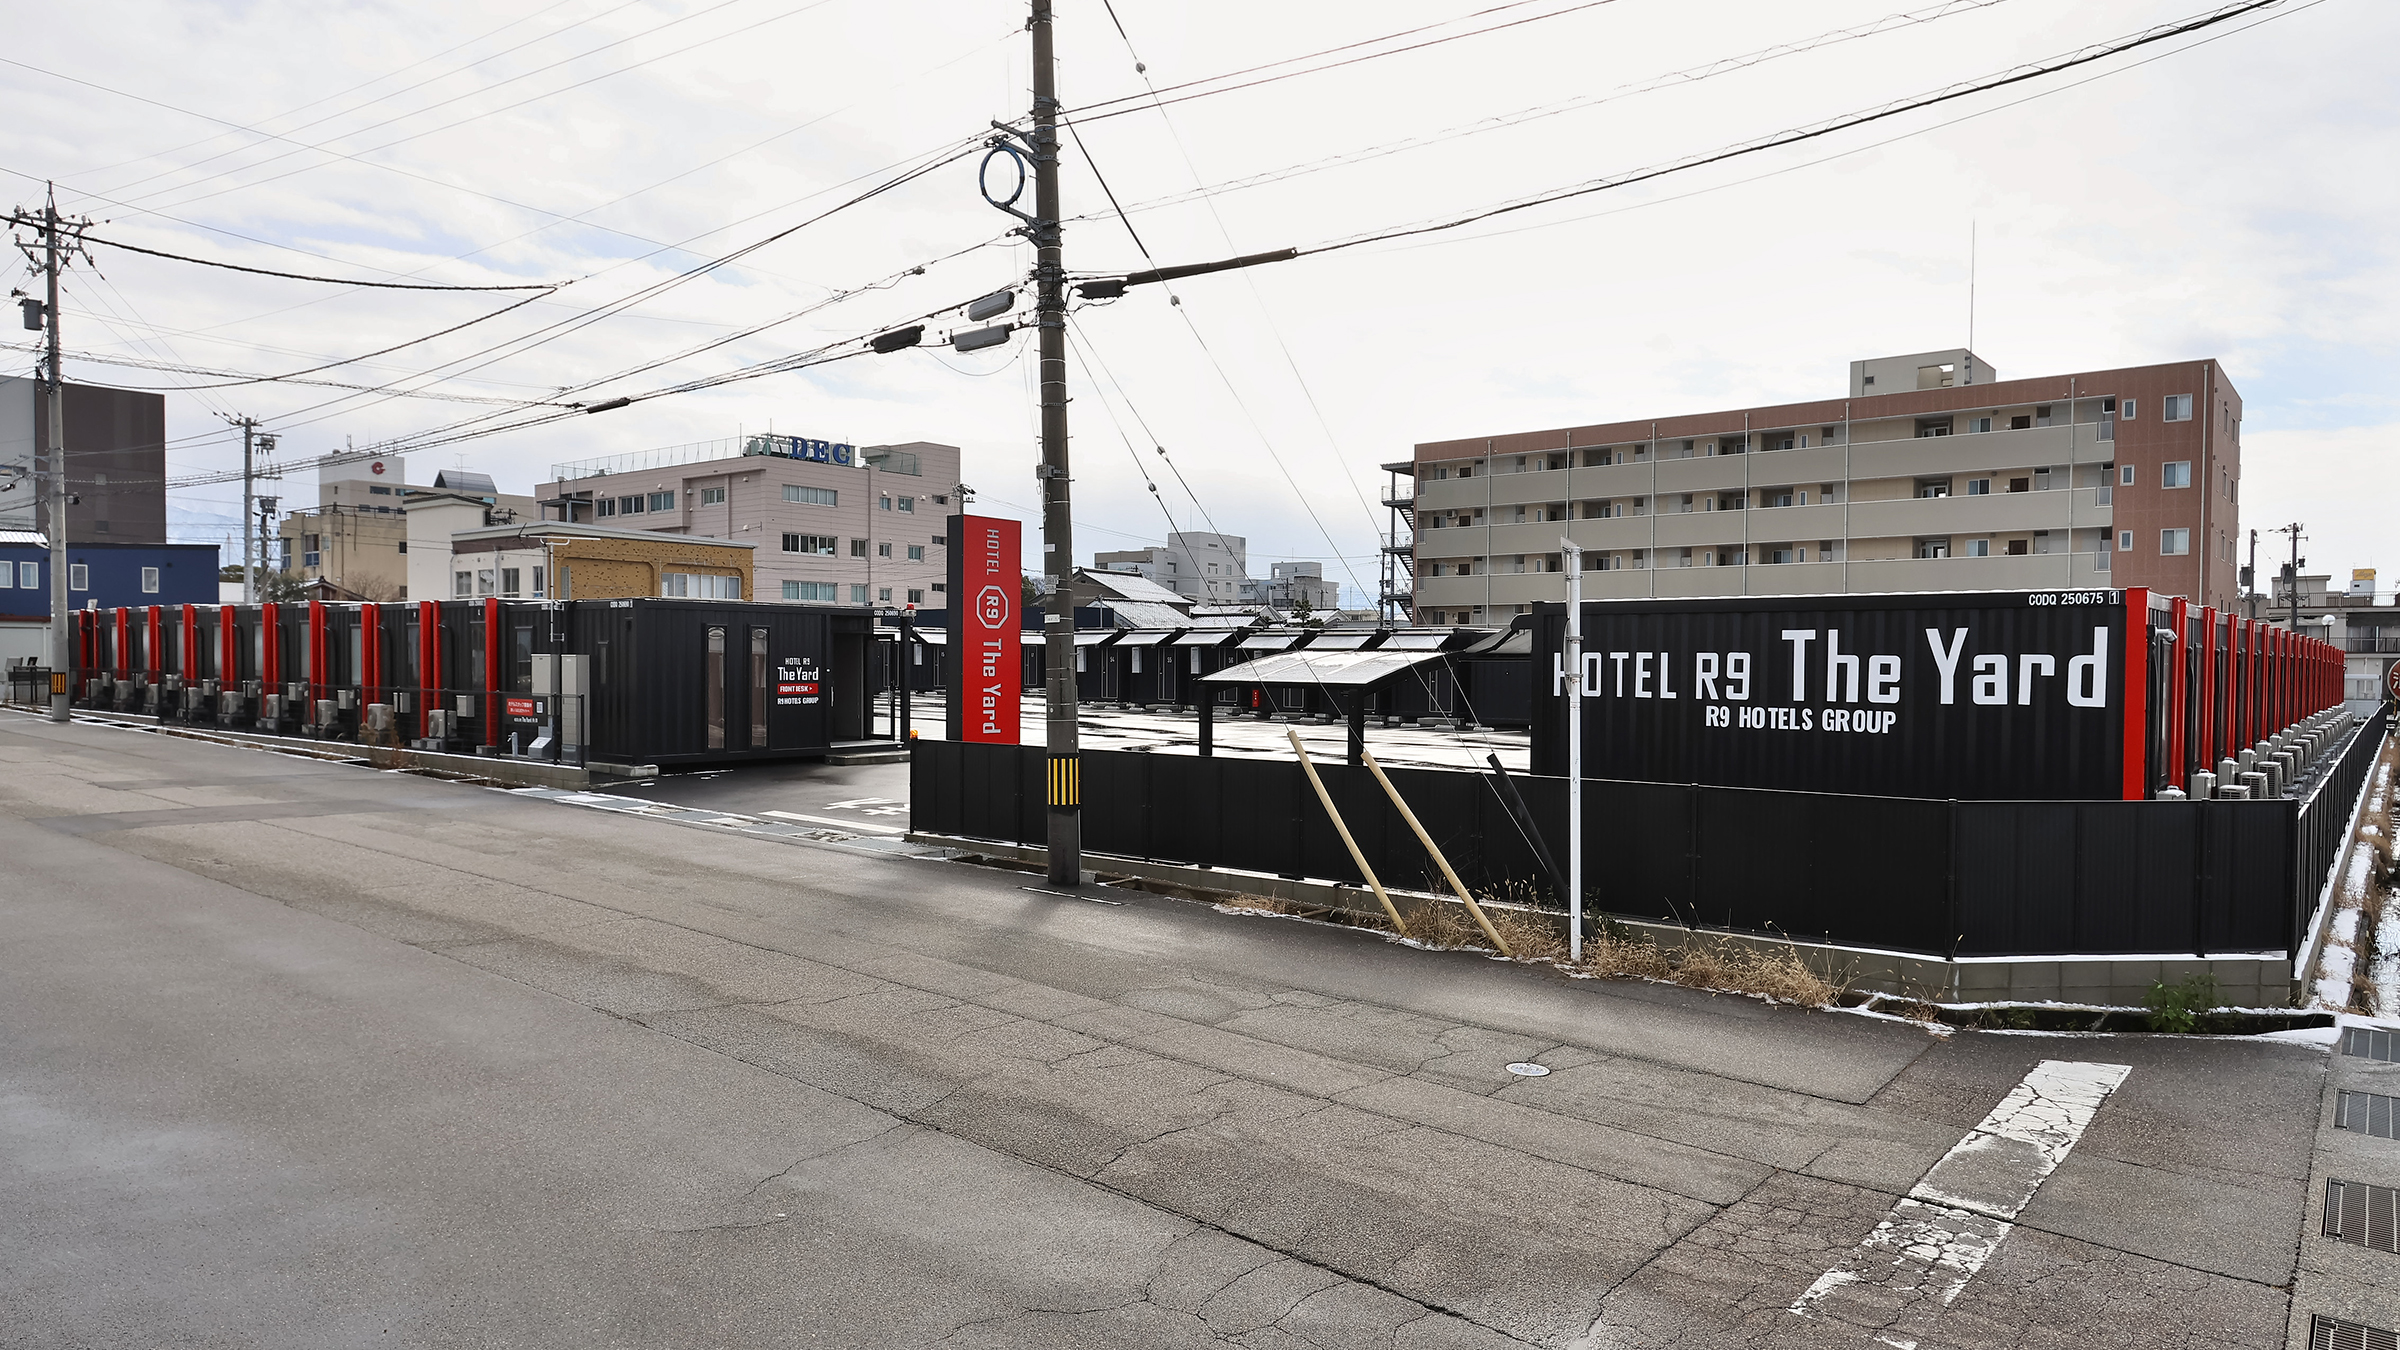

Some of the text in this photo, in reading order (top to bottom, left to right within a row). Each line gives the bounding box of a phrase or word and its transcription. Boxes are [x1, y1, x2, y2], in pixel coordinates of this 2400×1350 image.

[788, 436, 850, 464] DEC
[2028, 594, 2057, 606] CODQ
[2061, 592, 2104, 605] 250675
[982, 528, 1002, 734] HOTEL R9 The Yard
[778, 667, 819, 680] The Yard
[1695, 652, 1751, 701] R9
[1782, 629, 1901, 704] The
[1925, 626, 2108, 708] Yard
[1705, 705, 1897, 734] R9 HOTELS GROUP
